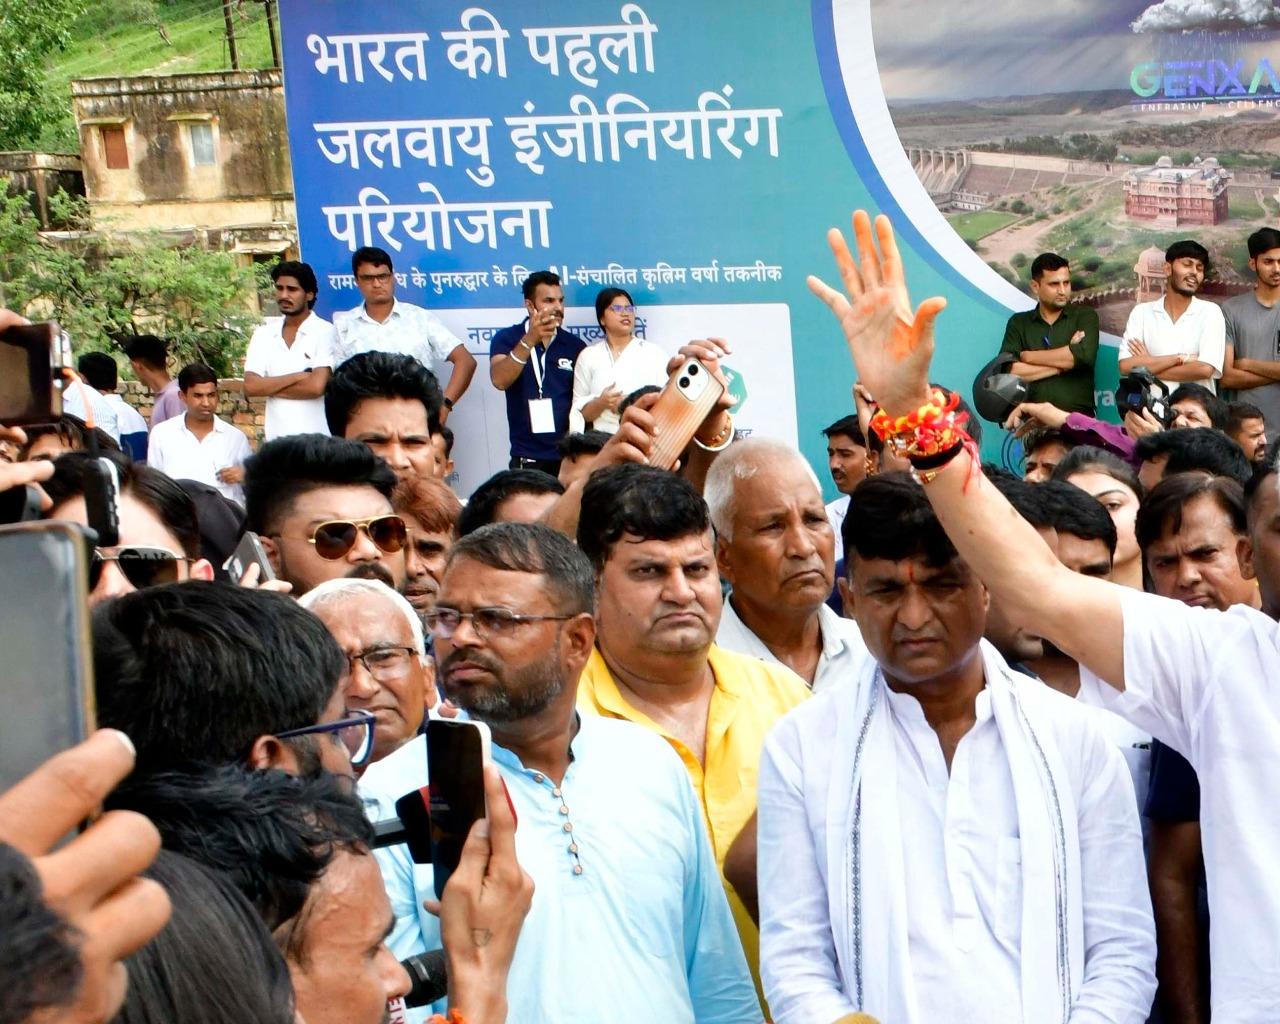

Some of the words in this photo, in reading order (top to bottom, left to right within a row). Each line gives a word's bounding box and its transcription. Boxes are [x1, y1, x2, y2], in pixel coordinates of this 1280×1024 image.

[307, 32, 429, 84] भारत
[442, 7, 510, 79] की
[523, 4, 658, 88] पहली
[313, 117, 495, 187] जलवायु
[505, 84, 783, 174] इंजीनियरिंग
[322, 182, 553, 252] परियोजना
[411, 267, 427, 287] के
[493, 265, 508, 287] के
[690, 260, 720, 283] वर्षा
[723, 260, 782, 283] तकनीक
